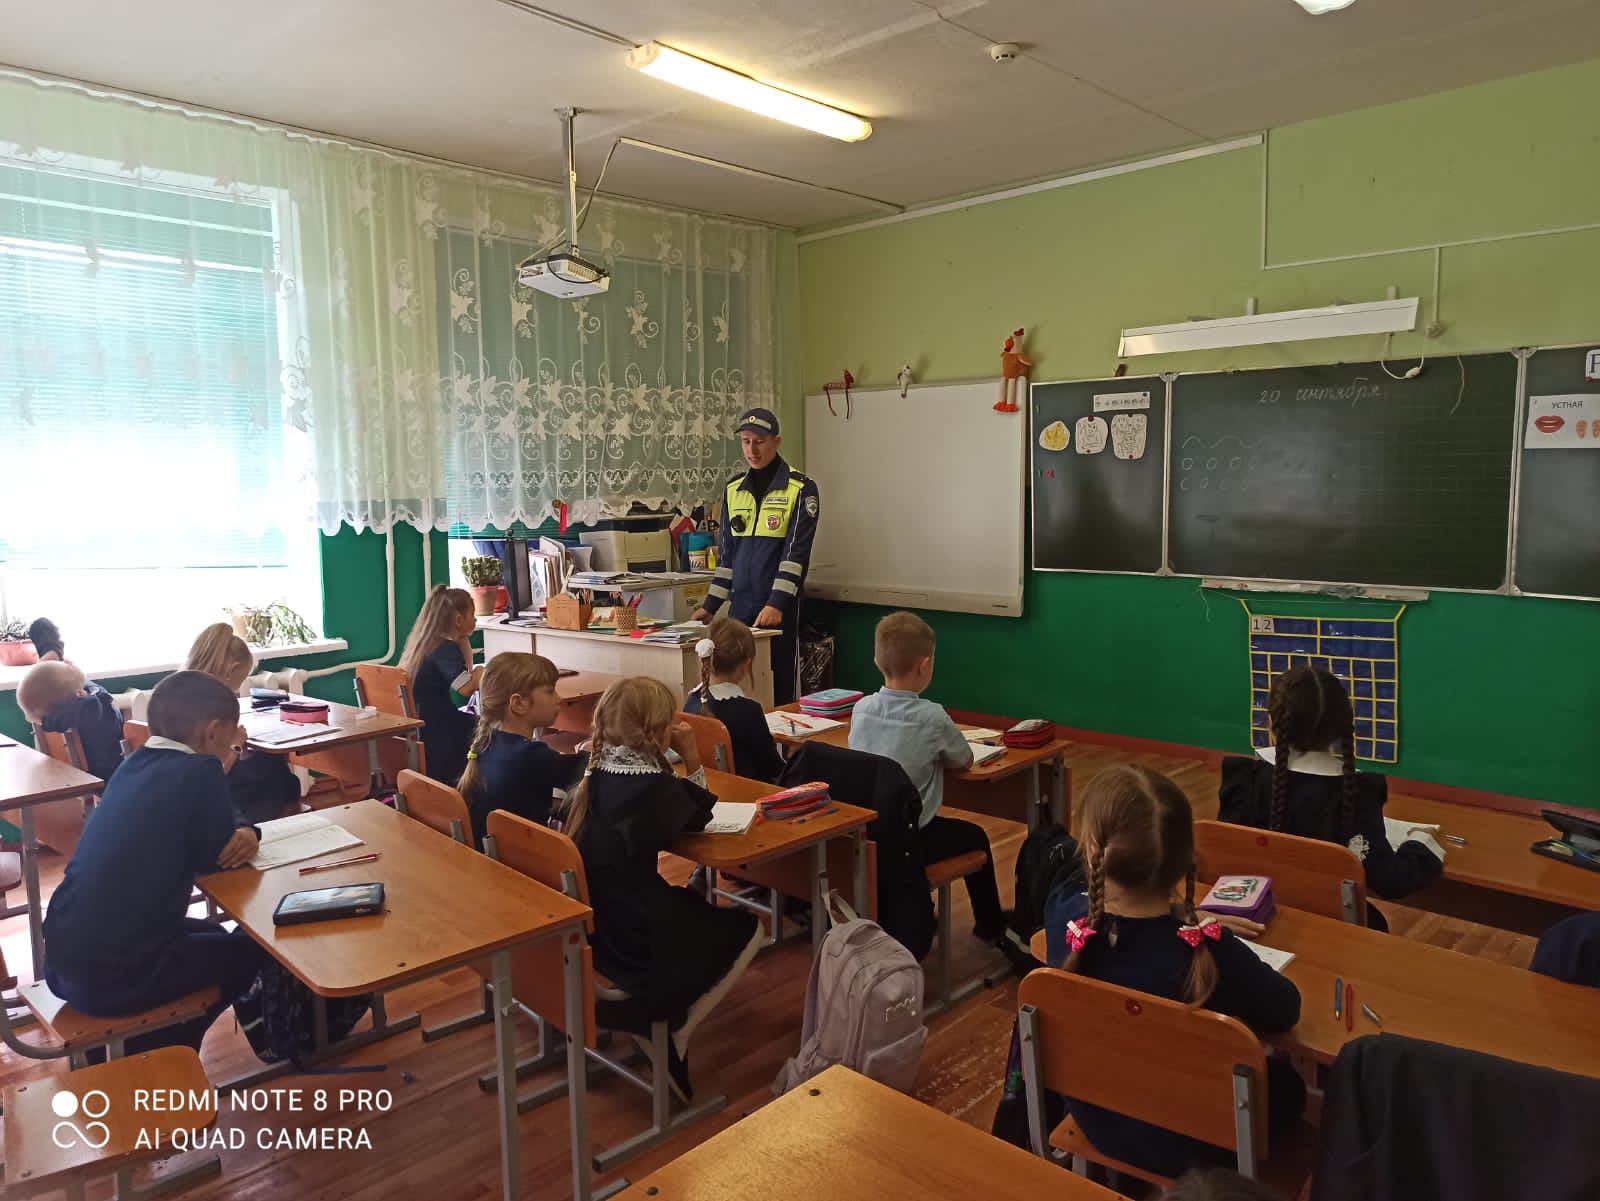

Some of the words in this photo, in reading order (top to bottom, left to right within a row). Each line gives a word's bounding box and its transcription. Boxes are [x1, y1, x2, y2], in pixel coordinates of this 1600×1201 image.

[1259, 389, 1281, 404] 20
[1551, 400, 1584, 409] УСТНАЯ
[1253, 619, 1272, 630] 12
